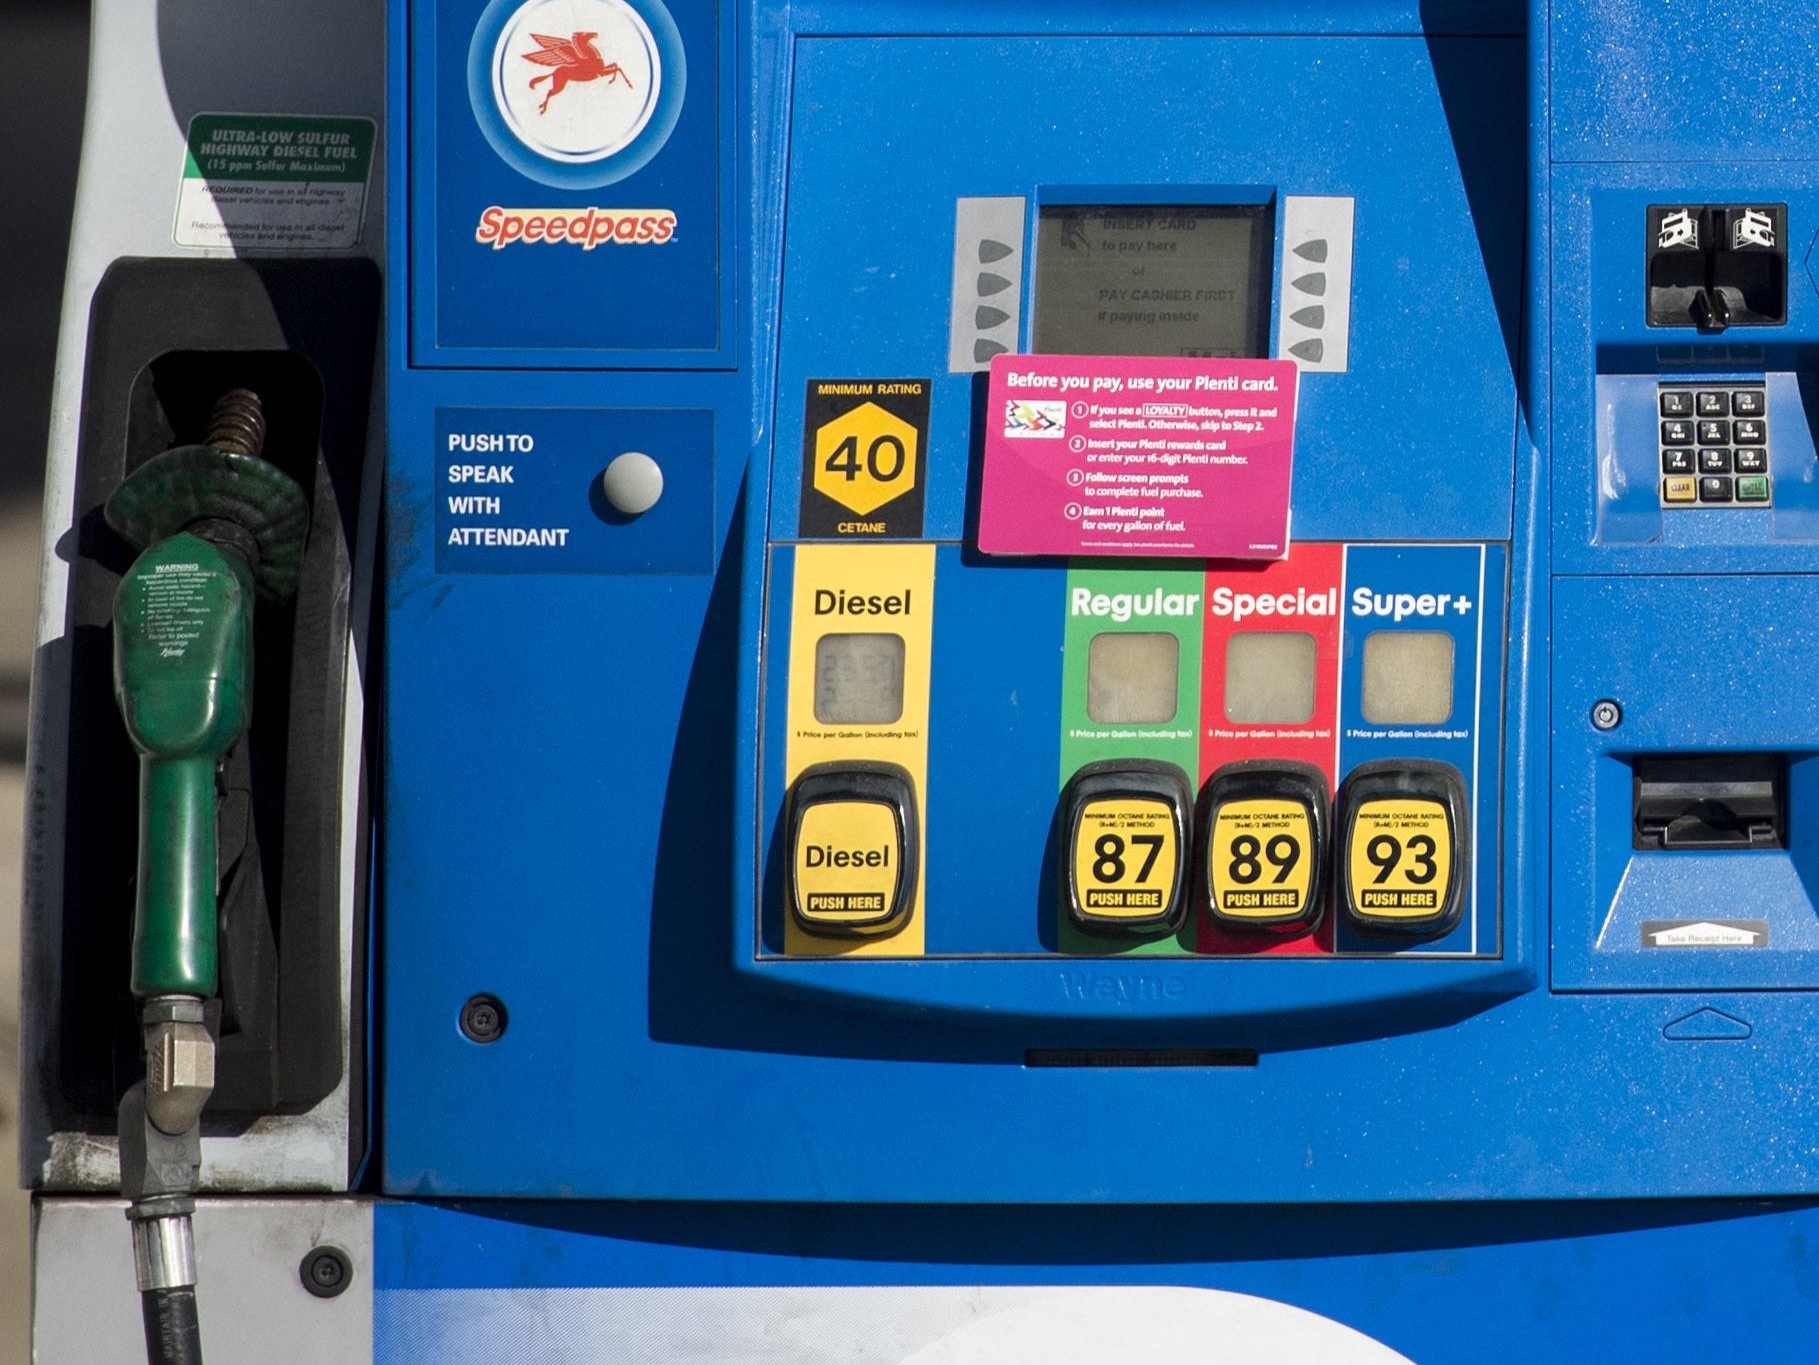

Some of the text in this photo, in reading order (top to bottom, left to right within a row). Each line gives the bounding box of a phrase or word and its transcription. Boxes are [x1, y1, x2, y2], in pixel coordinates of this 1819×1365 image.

[212, 130, 350, 145] ULTRA-LOW SULFUR
[200, 143, 357, 159] HIGHWAY DIESEL FUEL
[208, 159, 346, 173] (15 ppm Sulfur Maximum)
[477, 206, 676, 250] Speedpass
[1158, 219, 1196, 231] CARD
[818, 384, 922, 394] MINIMUM RATING
[1008, 373, 1278, 393] Before you pay, use your Plenti card.
[1100, 407, 1116, 417] you
[1145, 405, 1186, 416] LOYALTY
[448, 434, 534, 452] PUSH TO
[825, 435, 905, 482] 40
[448, 465, 514, 483] SPEAK
[448, 496, 500, 514] WITH
[838, 522, 886, 533] CETANE
[448, 528, 569, 546] ATTENDANT
[155, 563, 199, 572] WARNING
[814, 589, 911, 615] Diesel
[1071, 587, 1200, 621] Regular
[1211, 587, 1337, 621] Special
[1351, 587, 1472, 622] Super+
[806, 845, 889, 868] Diesel
[1092, 834, 1165, 884] 87
[1229, 834, 1301, 884] 89
[1366, 834, 1438, 884] 93
[811, 897, 881, 909] PUSH HERE
[1090, 893, 1159, 906] PUSH HERE
[1227, 893, 1296, 906] PUSH HERE
[1365, 894, 1434, 907] PUSH HERE
